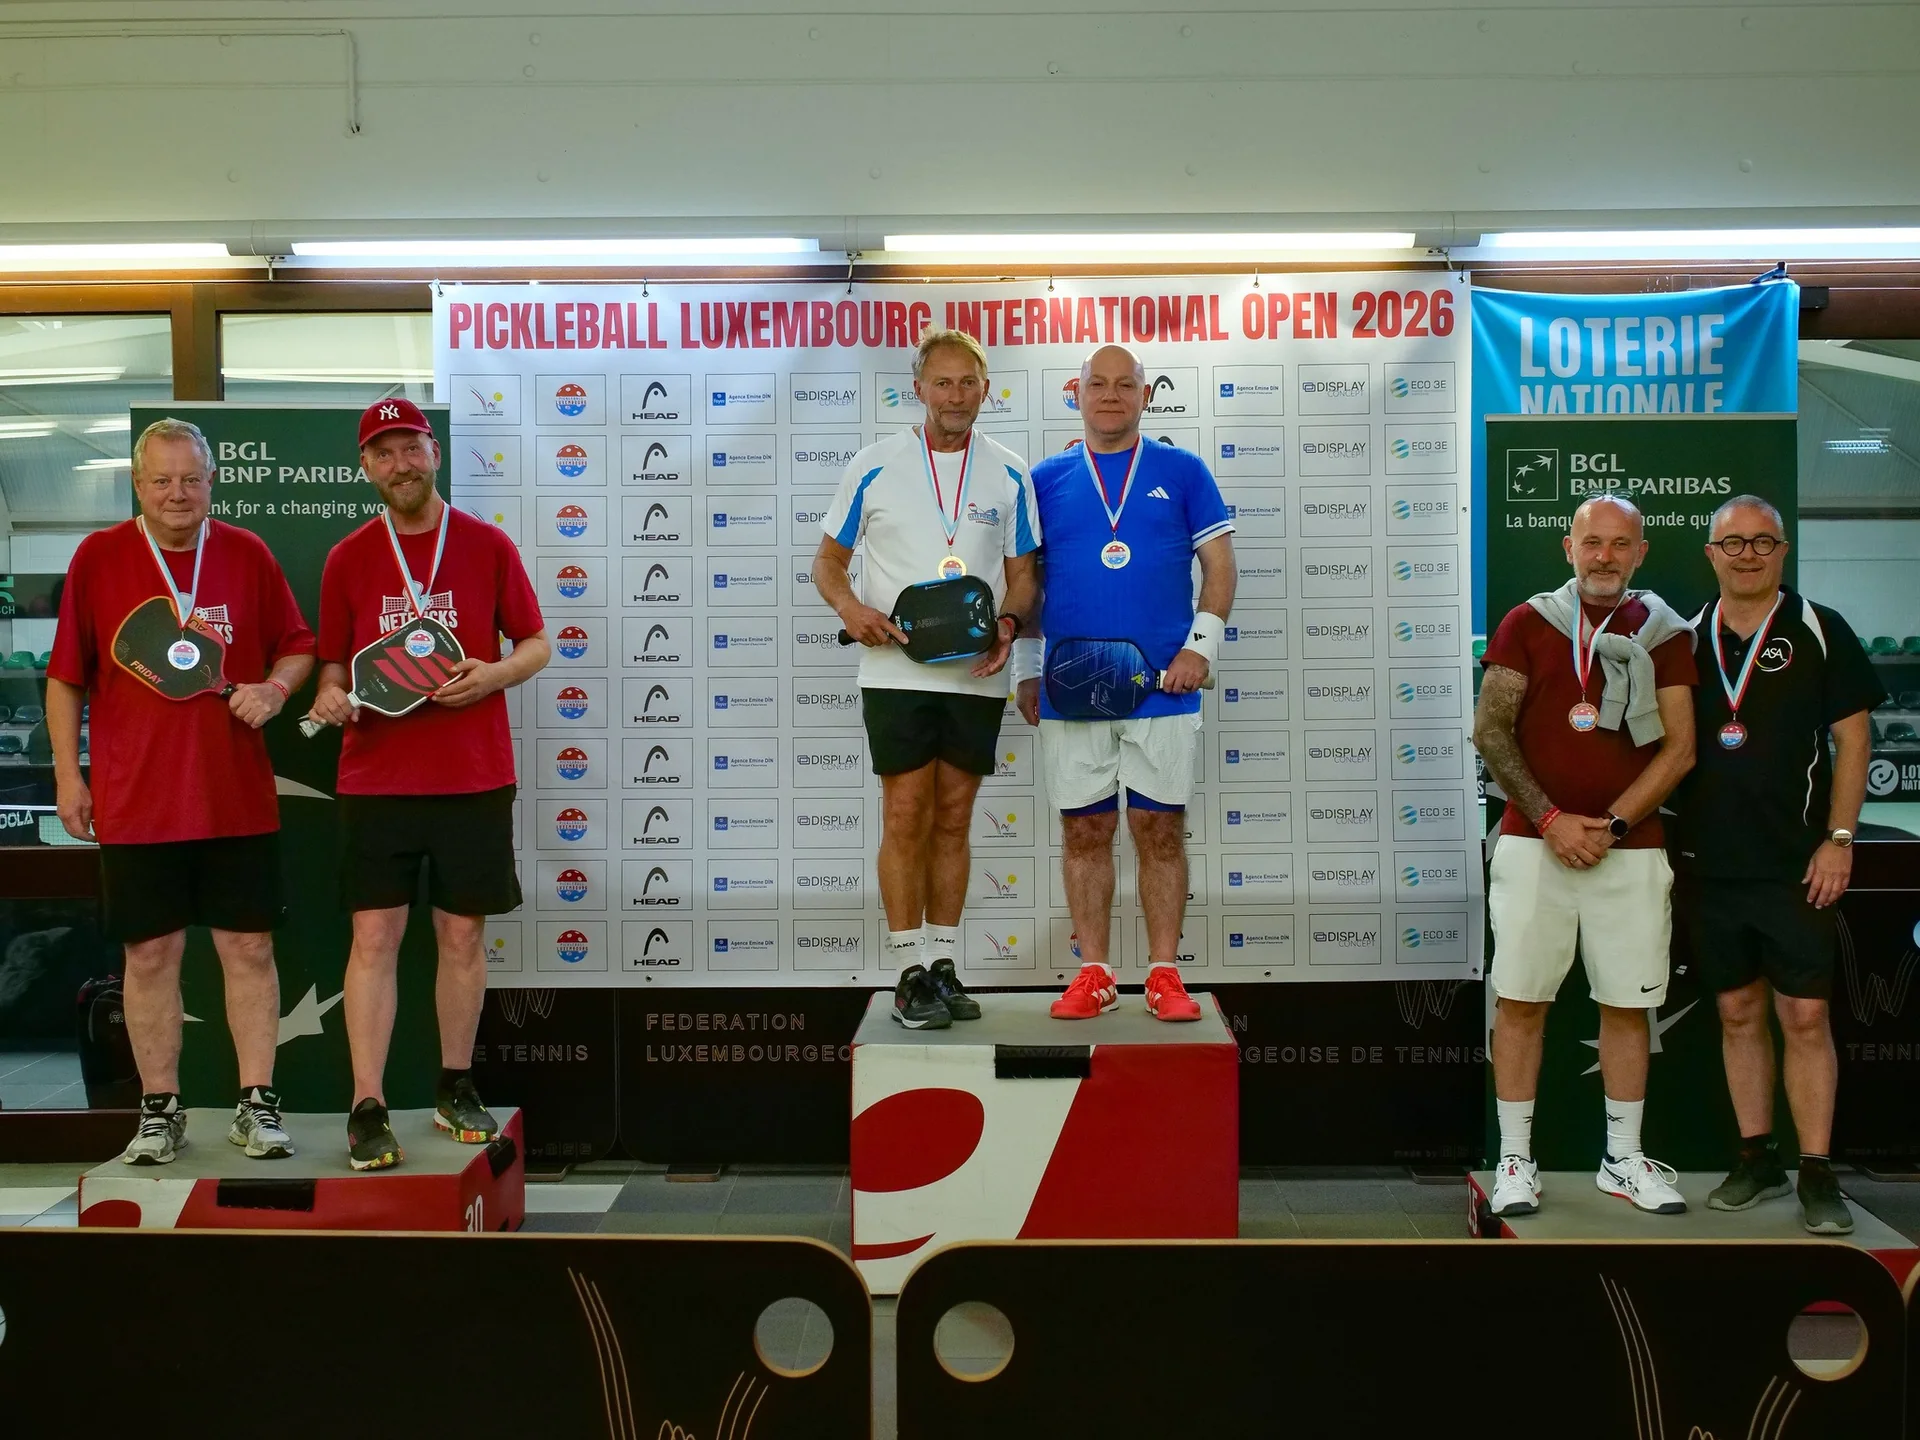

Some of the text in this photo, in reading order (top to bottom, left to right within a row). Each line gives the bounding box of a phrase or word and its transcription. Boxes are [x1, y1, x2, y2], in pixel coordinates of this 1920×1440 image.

[450, 290, 1455, 350] PICKLEBALL LUXEMBOURG INTERNATIONAL OPEN 2026
[1519, 313, 1726, 378] LOTERIE
[1317, 382, 1366, 392] DISPLAY
[1411, 380, 1447, 389] ECO 3E
[808, 390, 857, 401] DISPLAY
[1519, 381, 1724, 414] NATIONALE
[632, 412, 679, 420] HEAD
[1318, 443, 1367, 453] DISPLAY
[1412, 441, 1448, 450] ECO 3E
[219, 442, 276, 461] BGL
[1570, 453, 1626, 473] BGL
[219, 466, 371, 483] BNP PARIBA
[1628, 477, 1732, 495] PARIBAS
[235, 500, 261, 519] for
[266, 505, 276, 515] a
[281, 500, 357, 519] changing
[1318, 504, 1367, 514] DISPLAY
[1413, 502, 1449, 511] ECO 3E
[1506, 514, 1523, 528] La
[1528, 513, 1572, 531] banqu
[1642, 512, 1685, 527] onde
[1320, 565, 1369, 575] DISPLAY
[1414, 563, 1450, 572] ECO 3E
[634, 594, 680, 602] HEAD
[1321, 626, 1370, 636] DISPLAY
[1415, 624, 1451, 633] ECO 3E
[811, 633, 837, 644] DISP
[1760, 647, 1784, 659] ASA
[130, 660, 164, 685] FRIDAY
[1322, 687, 1371, 697] DISPLAY
[1417, 685, 1453, 694] ECO 3E
[811, 694, 859, 704] DISPLAY
[1324, 748, 1372, 758] DISPLAY
[1418, 746, 1454, 755] ECO 3E
[811, 755, 859, 765] DISPLAY
[1325, 809, 1374, 819] DISPLAY
[1420, 807, 1456, 817] ECO 3E
[0, 809, 34, 829] OOLA
[811, 816, 860, 826] DISPLAY
[1327, 870, 1376, 880] DISPLAY
[1422, 869, 1458, 878] ECO 3E
[811, 876, 860, 886] DISPLAY
[1328, 932, 1377, 942] DISPLAY
[1423, 930, 1459, 939] ECO 3E
[812, 937, 860, 947] DISPLAY
[646, 1013, 806, 1031] FEDERATION
[498, 1044, 589, 1062] TENNIS
[646, 1044, 851, 1062] LUXEMBOURGEO
[1352, 1047, 1383, 1063] DE
[1396, 1047, 1485, 1063] TENNIS
[1846, 1043, 1920, 1060] TENNI
